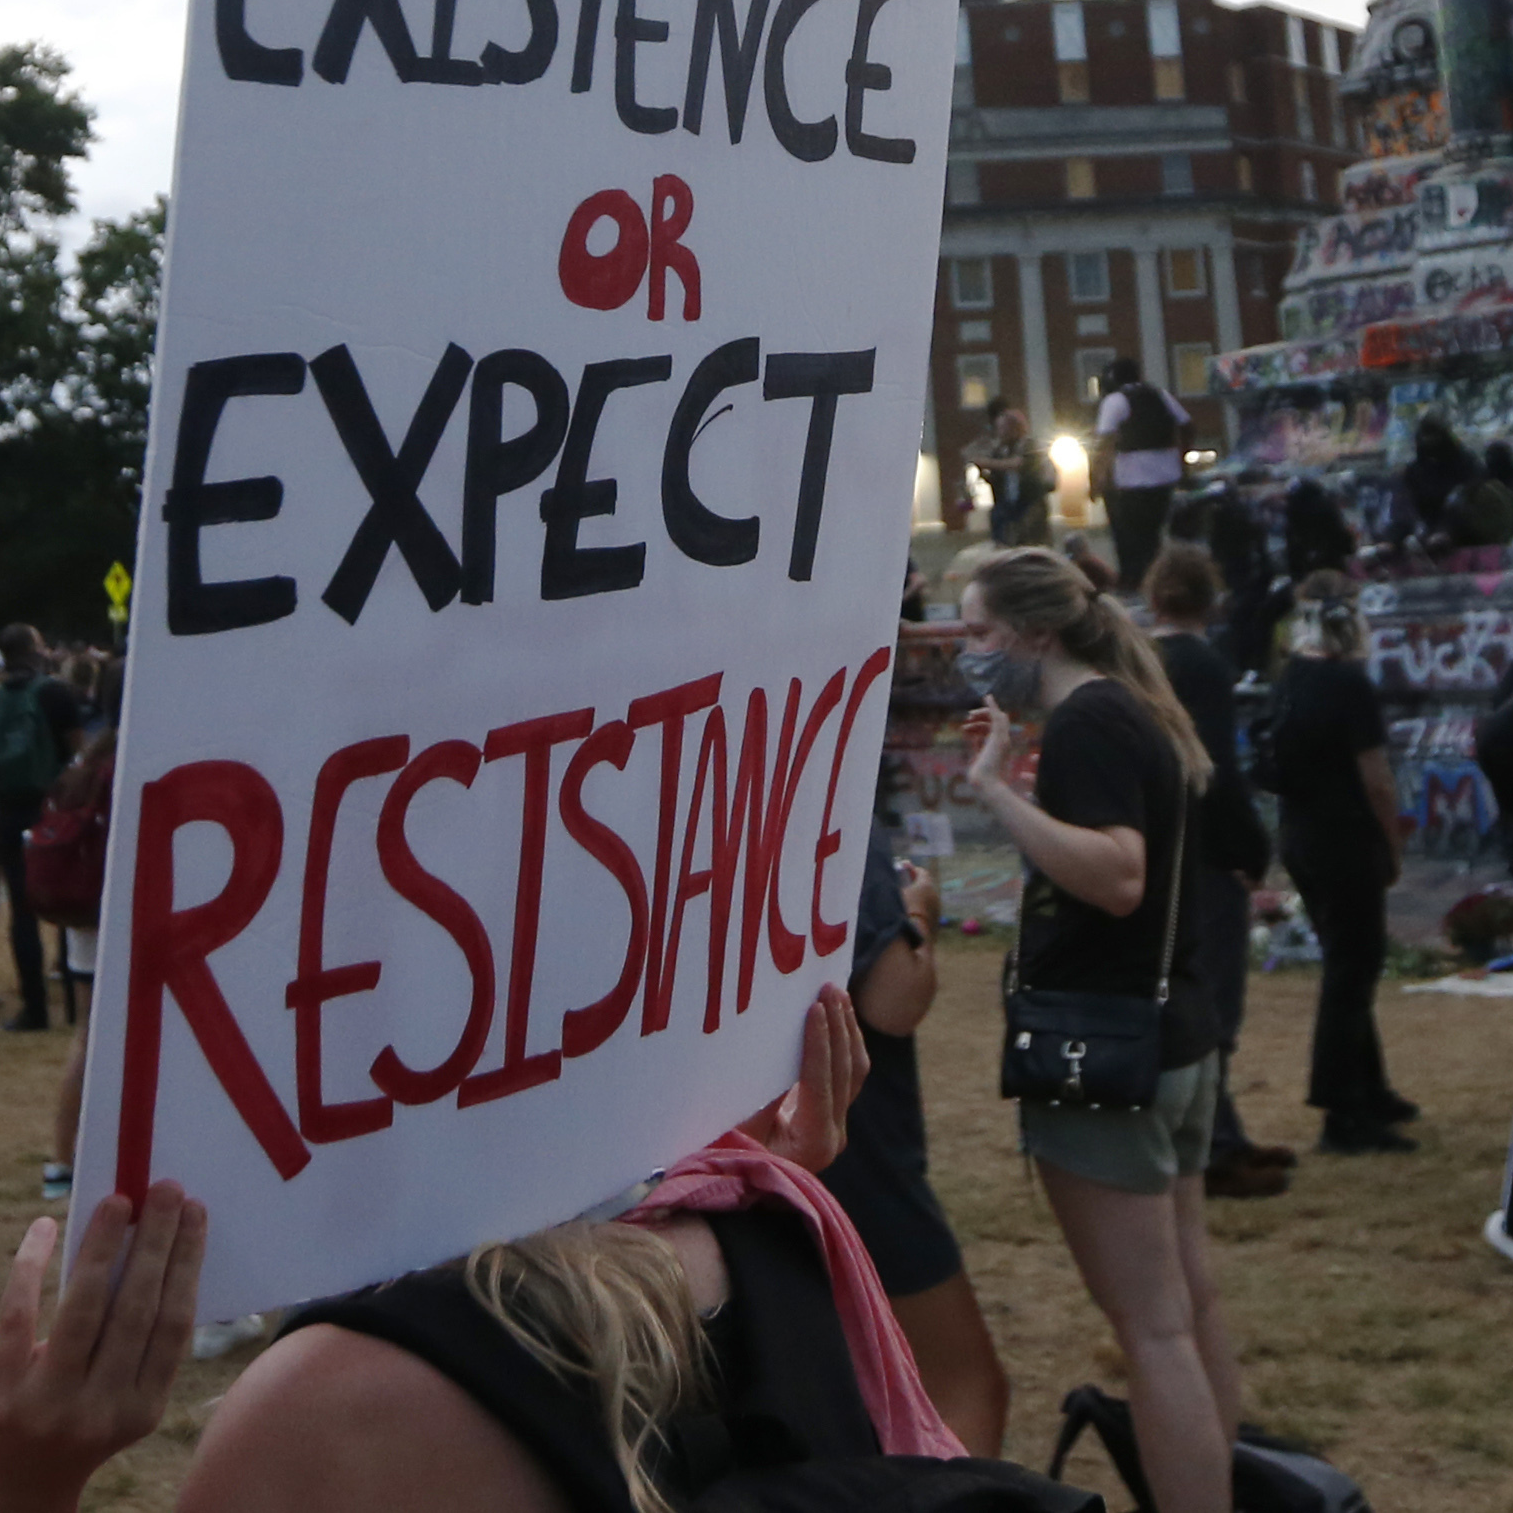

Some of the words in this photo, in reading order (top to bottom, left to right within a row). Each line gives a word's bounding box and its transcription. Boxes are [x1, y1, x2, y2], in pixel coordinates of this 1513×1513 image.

[557, 173, 701, 321] OR
[162, 336, 877, 636] EXPECT
[114, 645, 891, 1225] RESISTANCE
